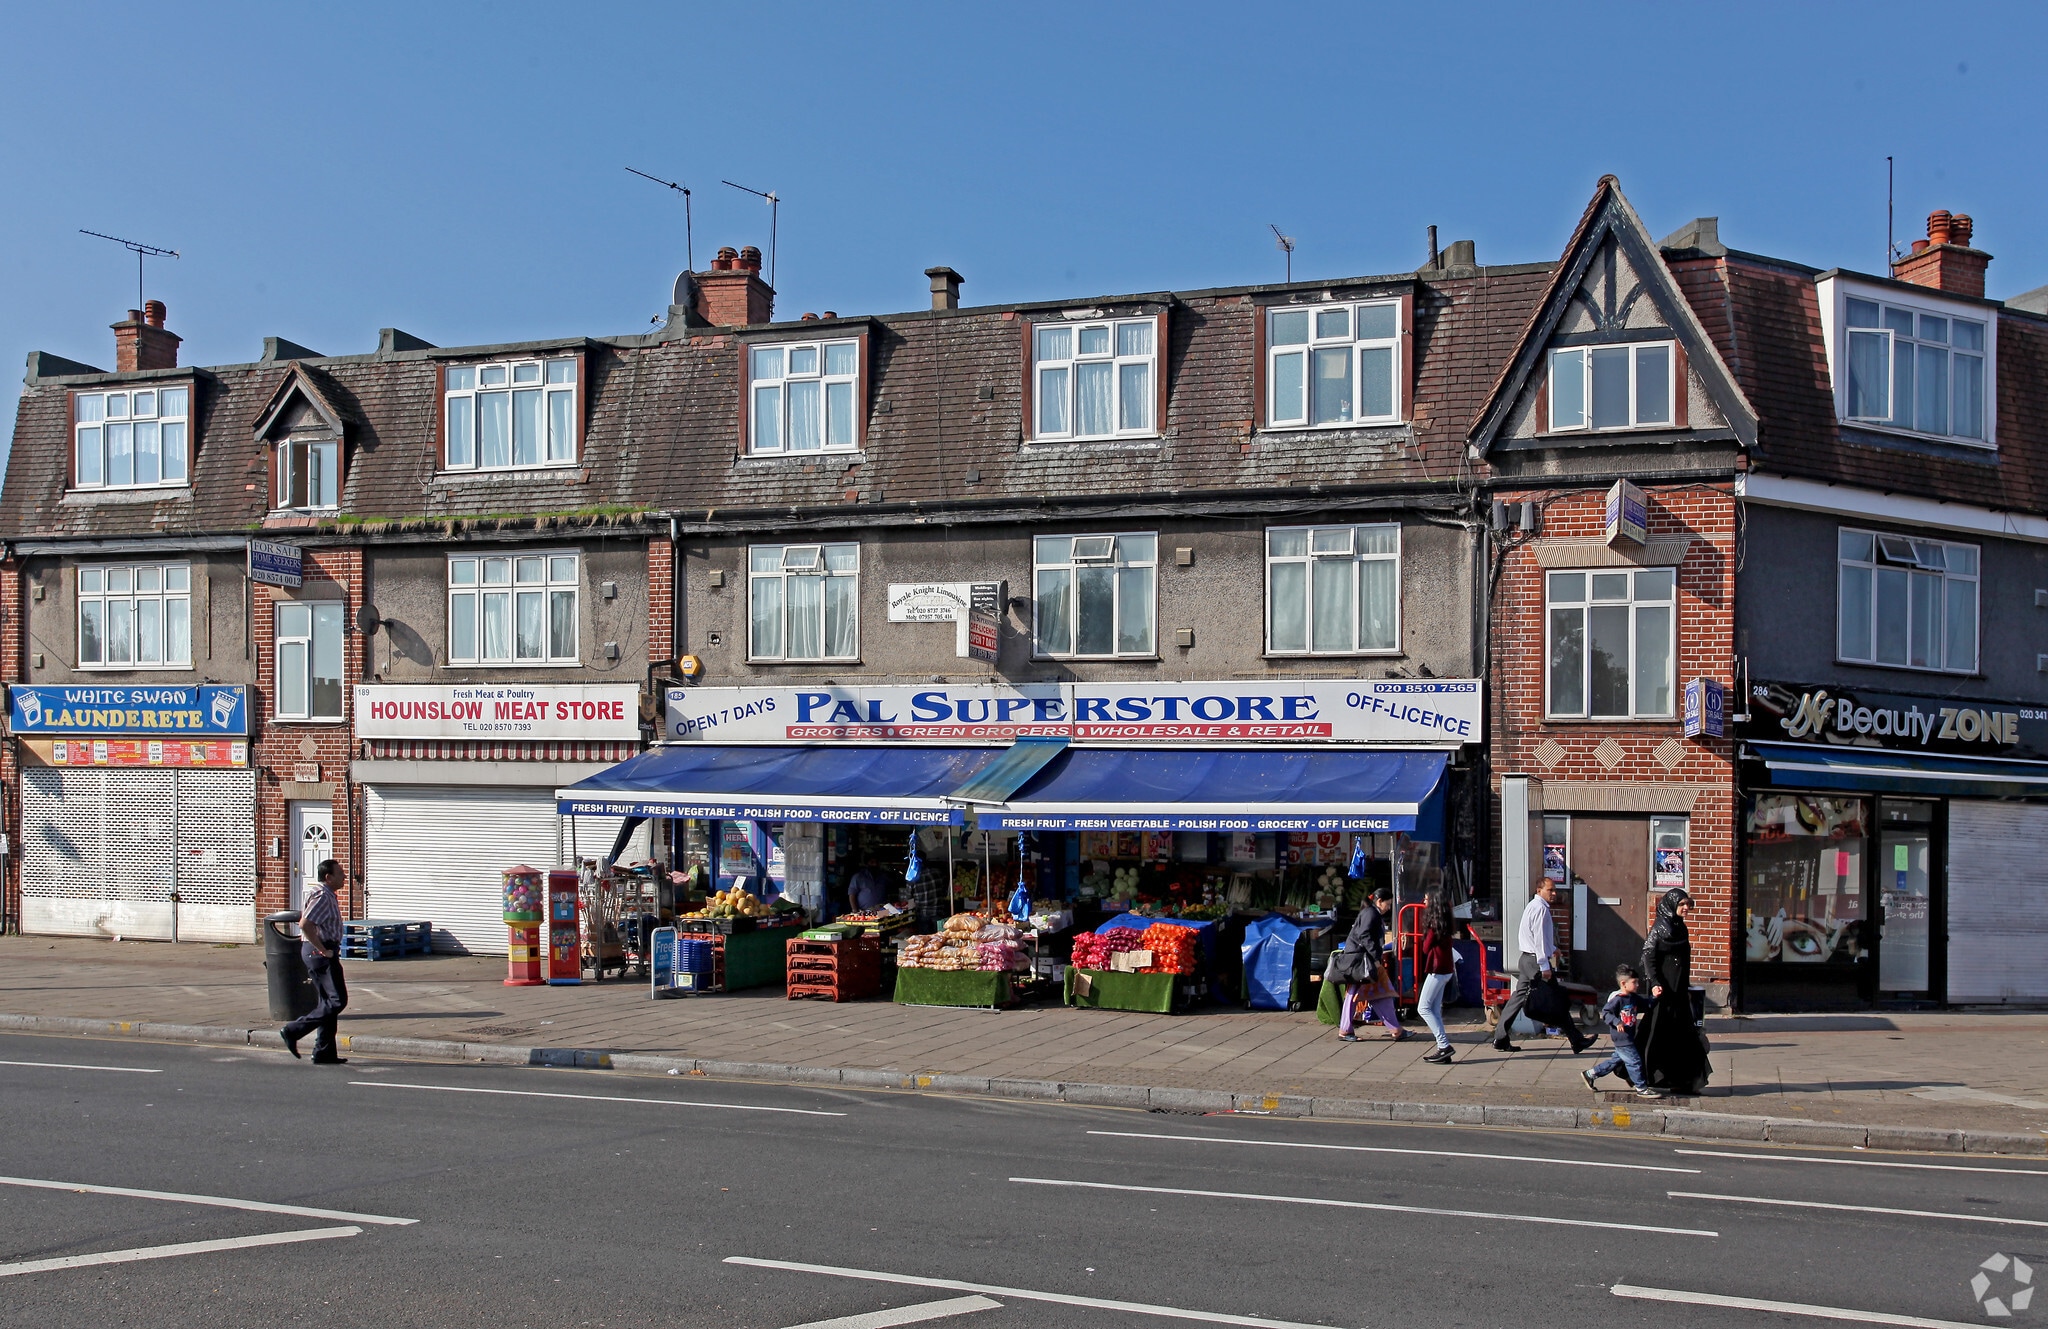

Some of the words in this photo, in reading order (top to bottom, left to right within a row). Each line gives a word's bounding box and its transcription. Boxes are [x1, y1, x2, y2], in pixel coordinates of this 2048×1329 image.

[254, 542, 274, 553] FOR
[276, 547, 300, 558] SALE
[253, 552, 272, 564] HOME
[274, 556, 302, 568] SEEKERS
[253, 571, 266, 580] 020
[267, 573, 283, 582] 8574
[285, 575, 300, 586] 0012
[891, 592, 912, 609] Royale
[913, 586, 935, 596] Knight
[936, 586, 968, 608] Limousine
[970, 622, 996, 636] OFF-LICENCE
[358, 688, 370, 696] 189
[453, 690, 473, 698] Fresh
[476, 690, 494, 698] Meat
[496, 690, 504, 698] &
[507, 690, 535, 700] Poultry
[1375, 684, 1402, 692] 020
[1753, 686, 1768, 696] 286
[65, 690, 126, 704] WHITE
[131, 690, 187, 704] SWAN
[371, 701, 483, 720] HOUNSLOW
[495, 701, 550, 720] MEAT
[556, 701, 624, 720] STORE
[795, 692, 898, 724] PAL
[911, 692, 1320, 724] SUPERSTORE
[1346, 692, 1472, 736] OFF-LICENCE
[2020, 710, 2033, 718] 020
[44, 709, 204, 728] LAUNDERETE
[676, 713, 718, 736] OPEN
[720, 710, 728, 724] 7
[732, 697, 776, 721] DAYS
[1714, 712, 1722, 720] SALE
[1838, 698, 1936, 744] Beauty
[1938, 708, 2020, 744] ZONE
[463, 722, 478, 732] TEL
[480, 722, 493, 732] 020
[494, 722, 512, 732] 8570
[514, 722, 532, 732] 7393
[791, 728, 882, 738] GROCERS
[899, 728, 966, 738] GREEN
[970, 727, 1070, 738] GROCERS
[1090, 726, 1222, 737] WHOLESALE
[1227, 726, 1242, 736] &
[1246, 725, 1326, 736] RETAIL
[572, 804, 603, 814] FRESH
[606, 805, 634, 814] FRUIT
[643, 806, 675, 816] FRESH
[677, 807, 736, 817] VEGETABLE
[744, 809, 782, 818] POLISH
[784, 810, 812, 819] FOOD
[820, 811, 871, 820] GROCERY
[880, 812, 900, 820] OFF
[902, 812, 950, 822] LICENCE
[1002, 819, 1034, 828] FRESH
[1036, 820, 1066, 828] FRUIT
[1110, 820, 1170, 828] VEGETABLE
[1178, 820, 1216, 828] POLISH
[1220, 820, 1248, 828] FOOD
[1258, 820, 1309, 828] GROCERY
[1318, 820, 1338, 828] OFF
[1342, 820, 1389, 828] LICENCE
[1322, 834, 1334, 847] £2
[656, 942, 673, 954] Free
